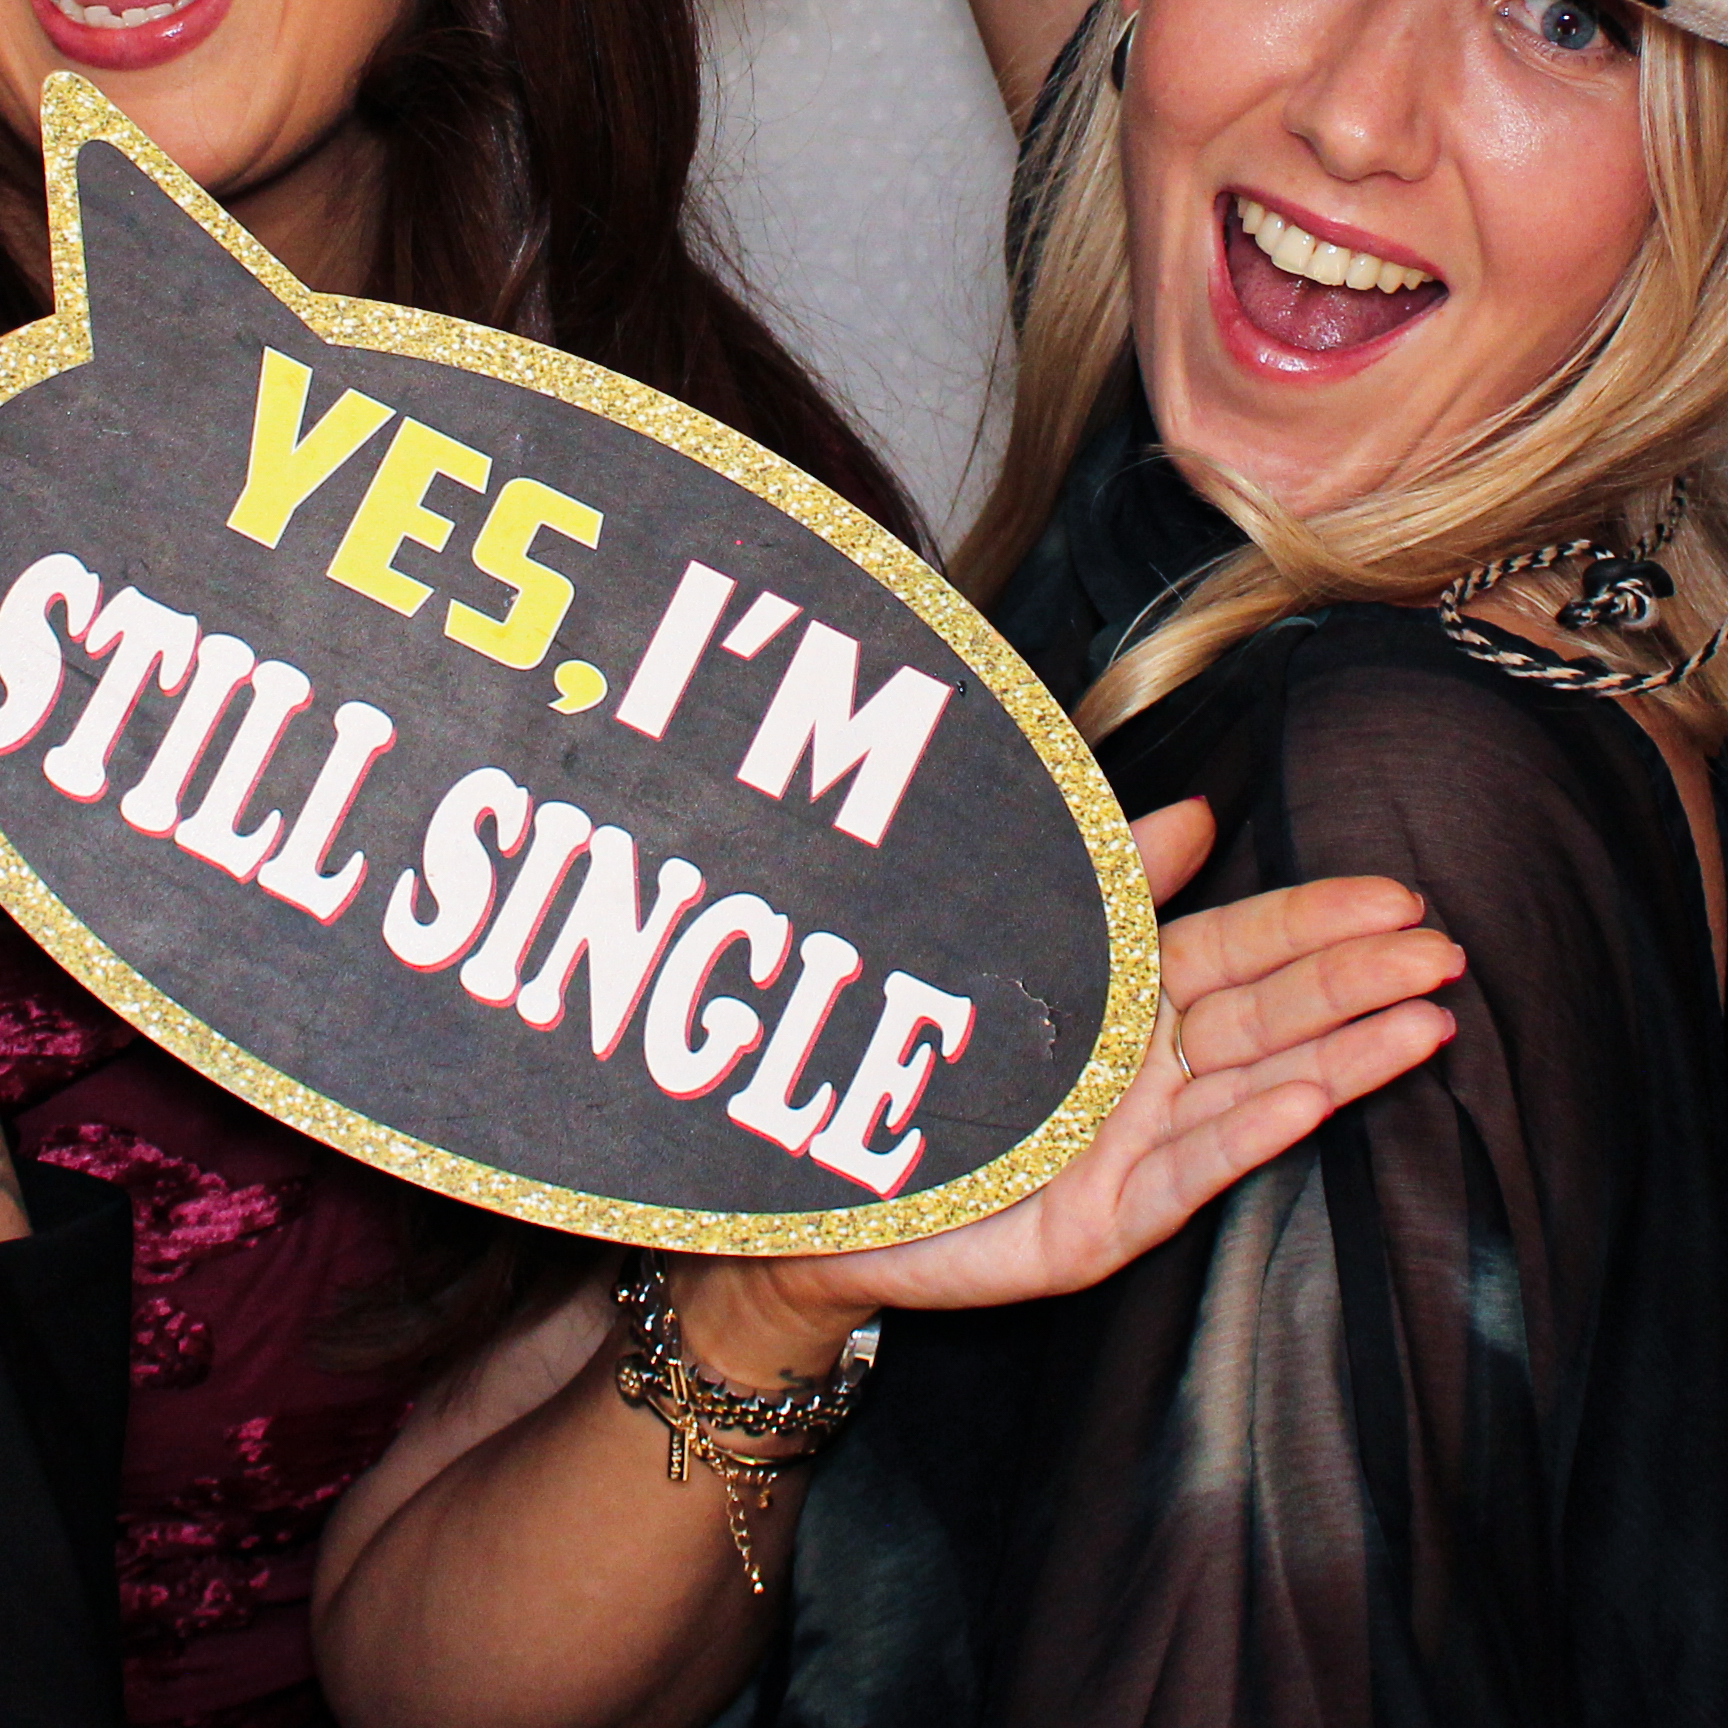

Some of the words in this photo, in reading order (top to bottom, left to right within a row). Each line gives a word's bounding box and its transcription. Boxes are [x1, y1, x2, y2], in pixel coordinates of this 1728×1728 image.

[226, 345, 608, 716] YES,
[613, 559, 954, 848] I'M
[381, 767, 976, 1199] SINGLE
